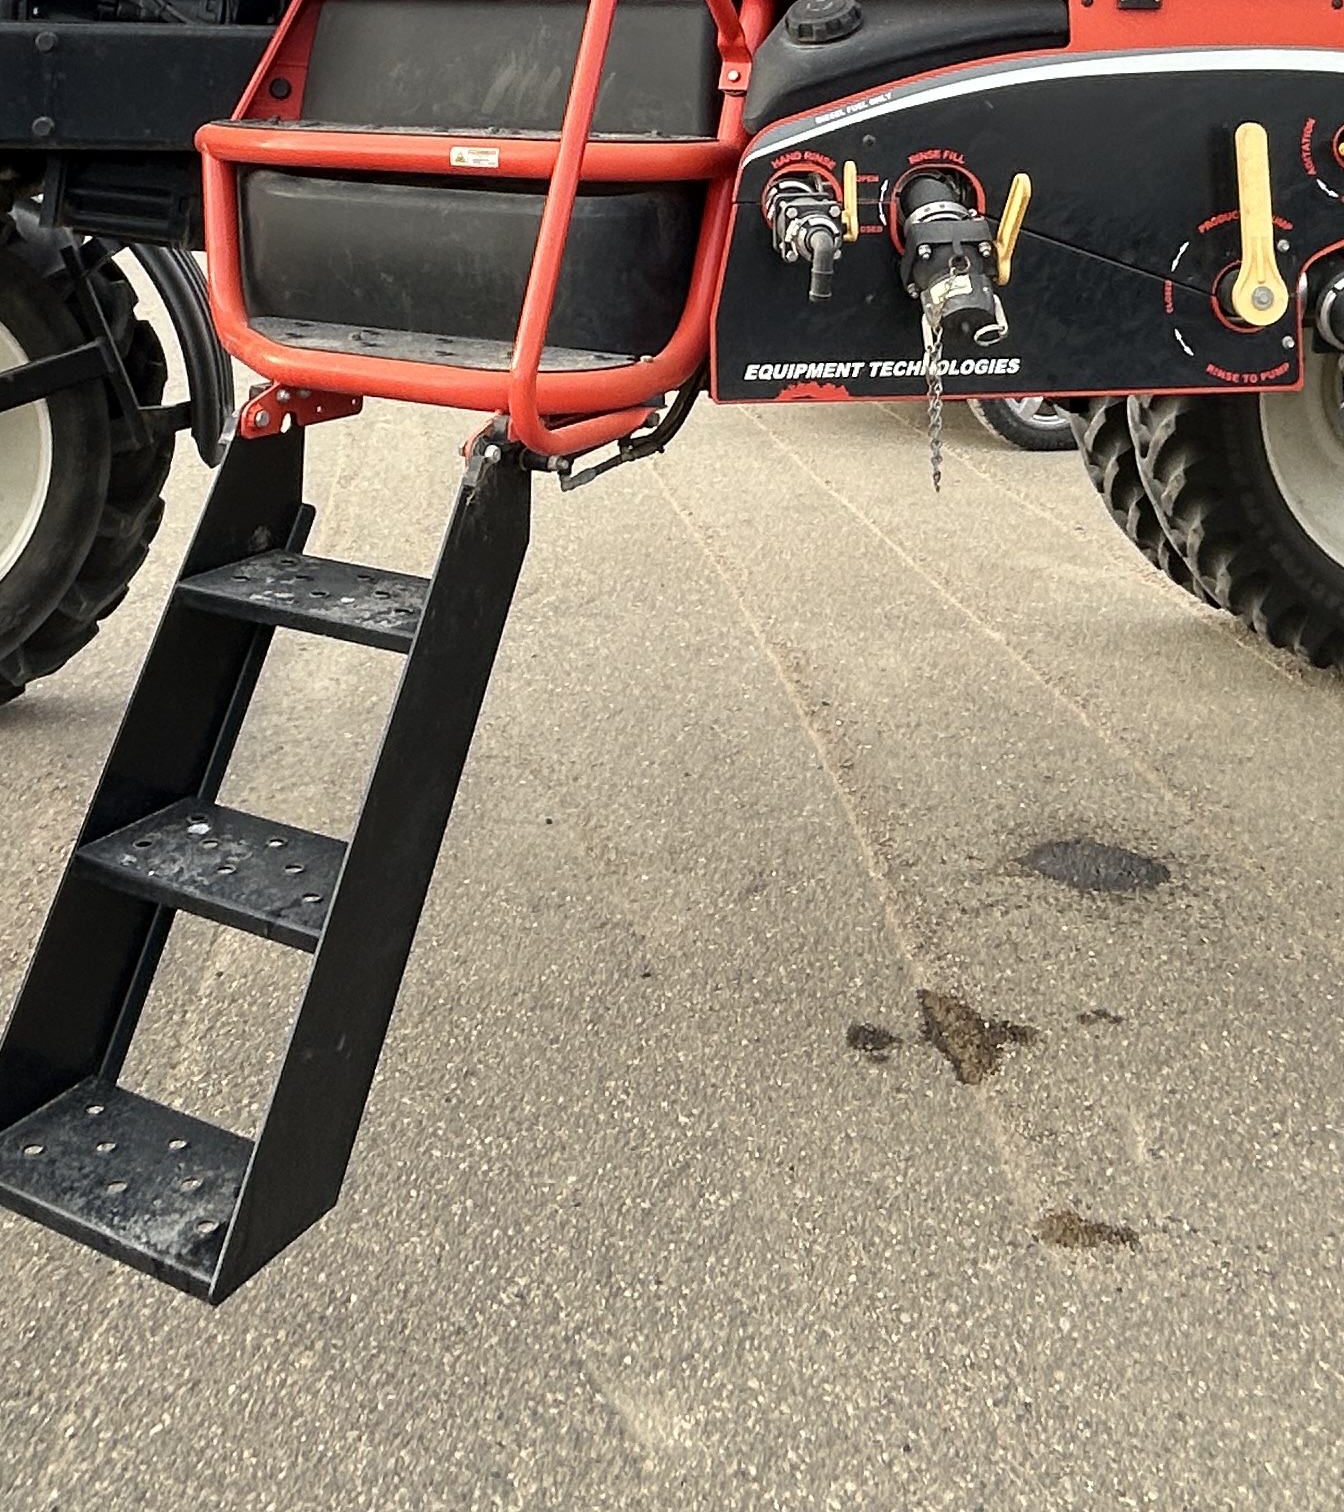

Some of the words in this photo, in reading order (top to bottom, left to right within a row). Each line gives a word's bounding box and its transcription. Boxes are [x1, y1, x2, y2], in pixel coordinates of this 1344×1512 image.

[908, 149, 940, 165] RINSE
[941, 148, 965, 165] FILL
[1300, 117, 1317, 176] AGITATION
[770, 150, 802, 169] HAND
[804, 151, 837, 171] RINSE
[744, 361, 864, 381] EQUIPMENT
[1206, 362, 1241, 382] RINSE
[1241, 371, 1258, 384] TO
[1260, 361, 1291, 381] PUMP
